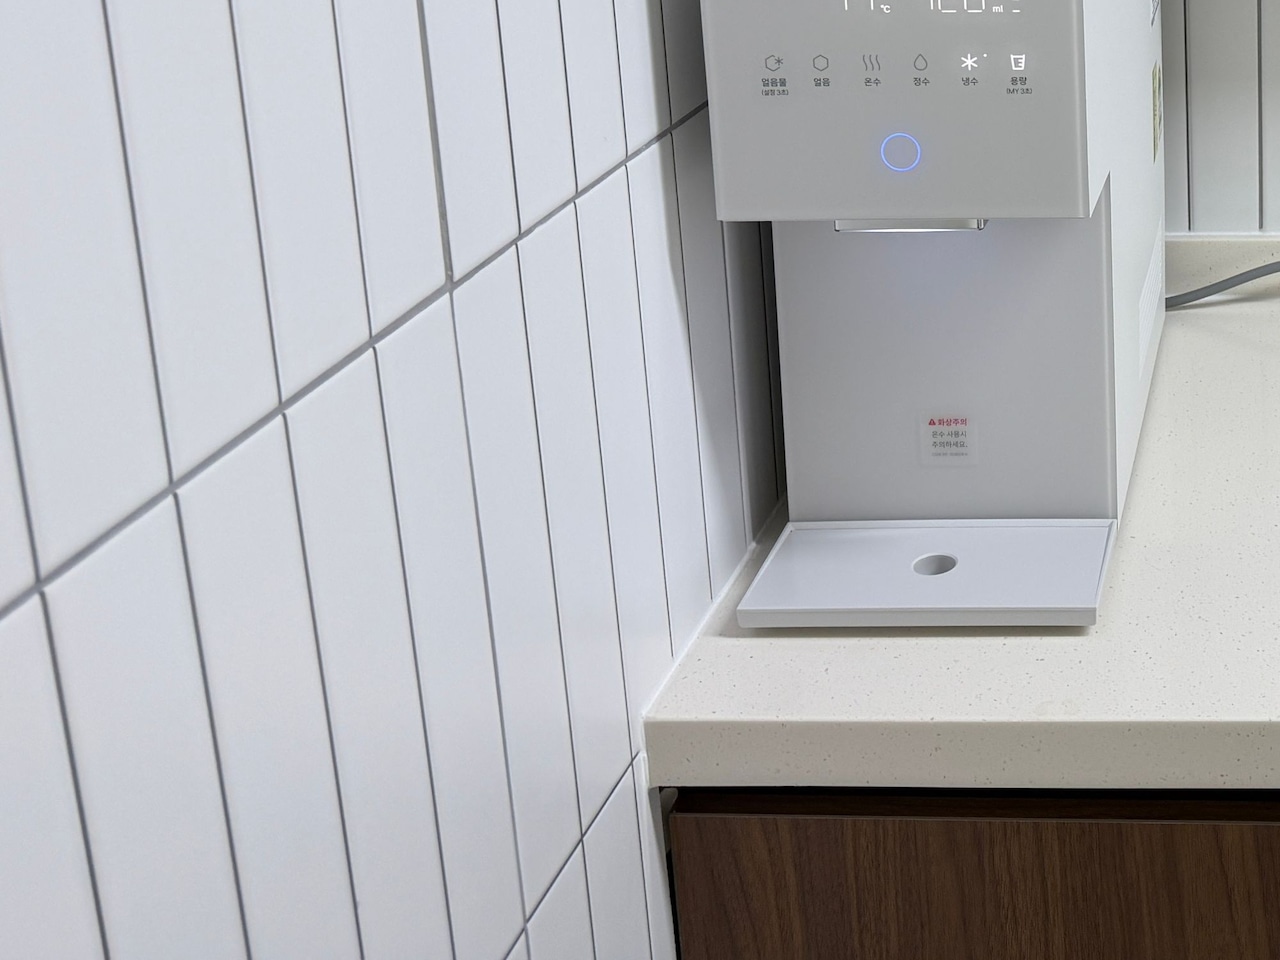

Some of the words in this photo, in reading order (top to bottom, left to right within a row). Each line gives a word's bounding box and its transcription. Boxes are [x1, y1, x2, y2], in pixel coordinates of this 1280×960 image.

[813, 77, 830, 87] 얼음
[864, 77, 881, 87] 온수
[913, 77, 930, 86] 정수
[961, 77, 978, 86] 냉수
[1010, 76, 1027, 86] 용량
[937, 418, 967, 426] 화상주의
